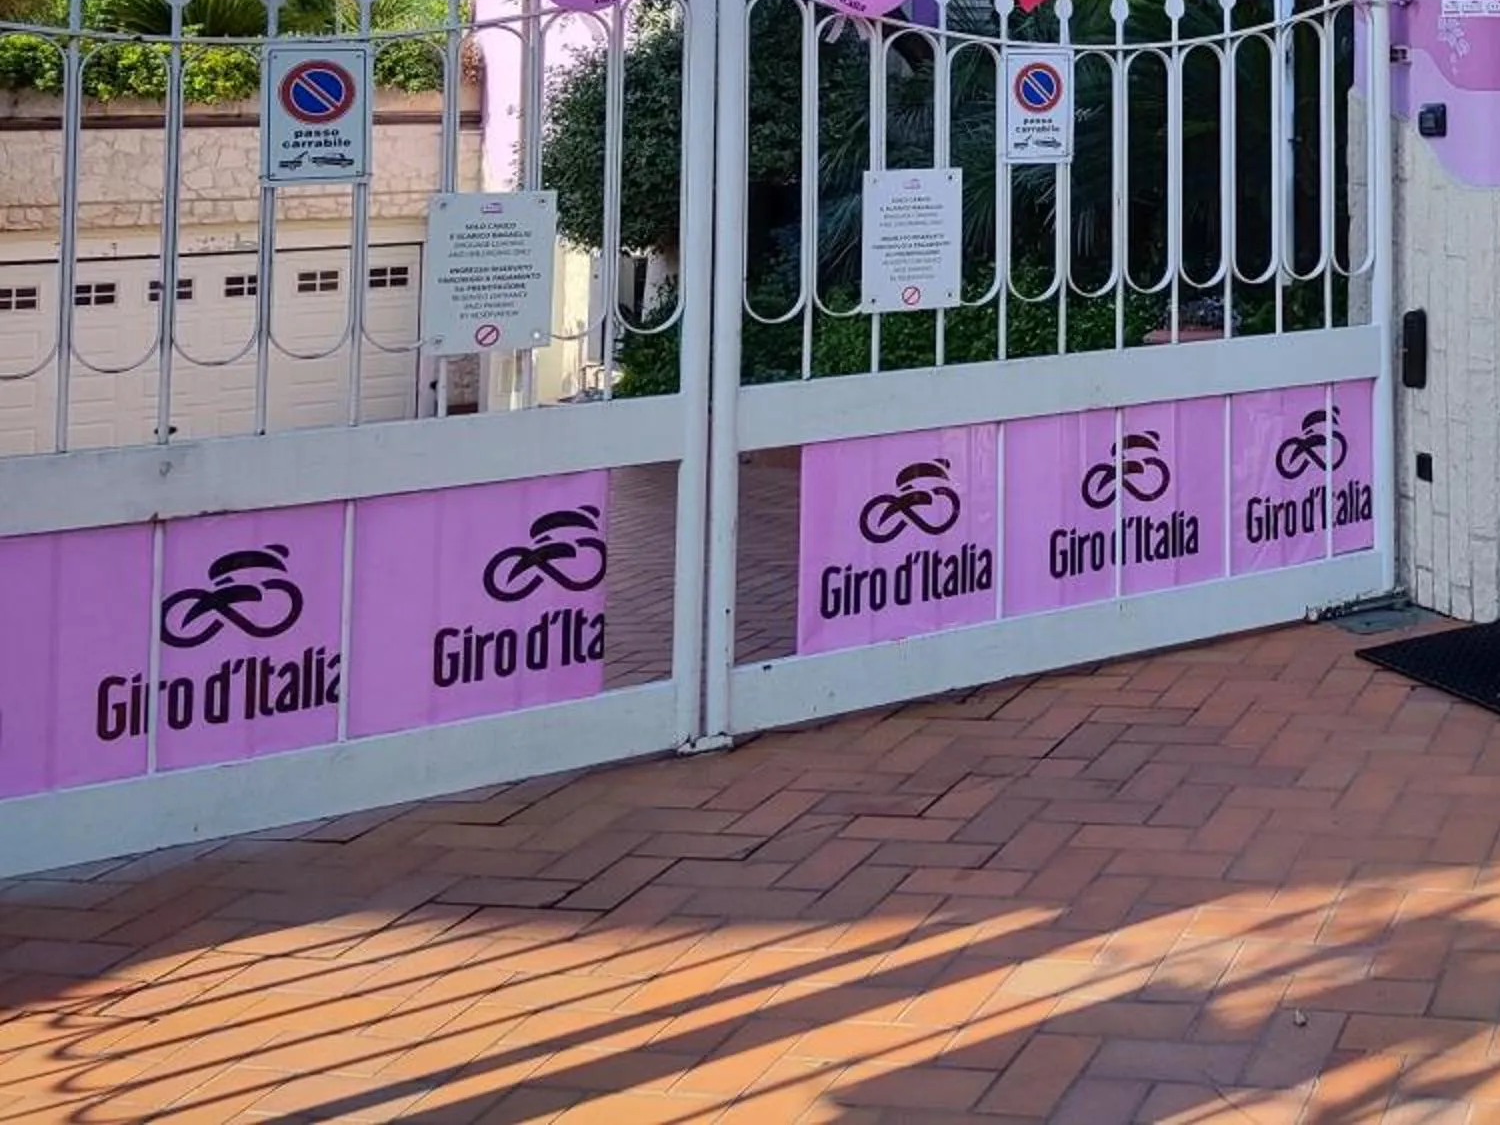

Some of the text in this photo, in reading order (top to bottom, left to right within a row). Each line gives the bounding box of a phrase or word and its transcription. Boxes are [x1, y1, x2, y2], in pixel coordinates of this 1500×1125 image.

[282, 138, 351, 149] carrabile
[294, 129, 339, 139] passo
[1246, 480, 1372, 543] Giro d'Ialia
[820, 543, 992, 619] Giro d'Italia
[1050, 528, 1105, 579] Giro
[433, 626, 517, 688] Giro
